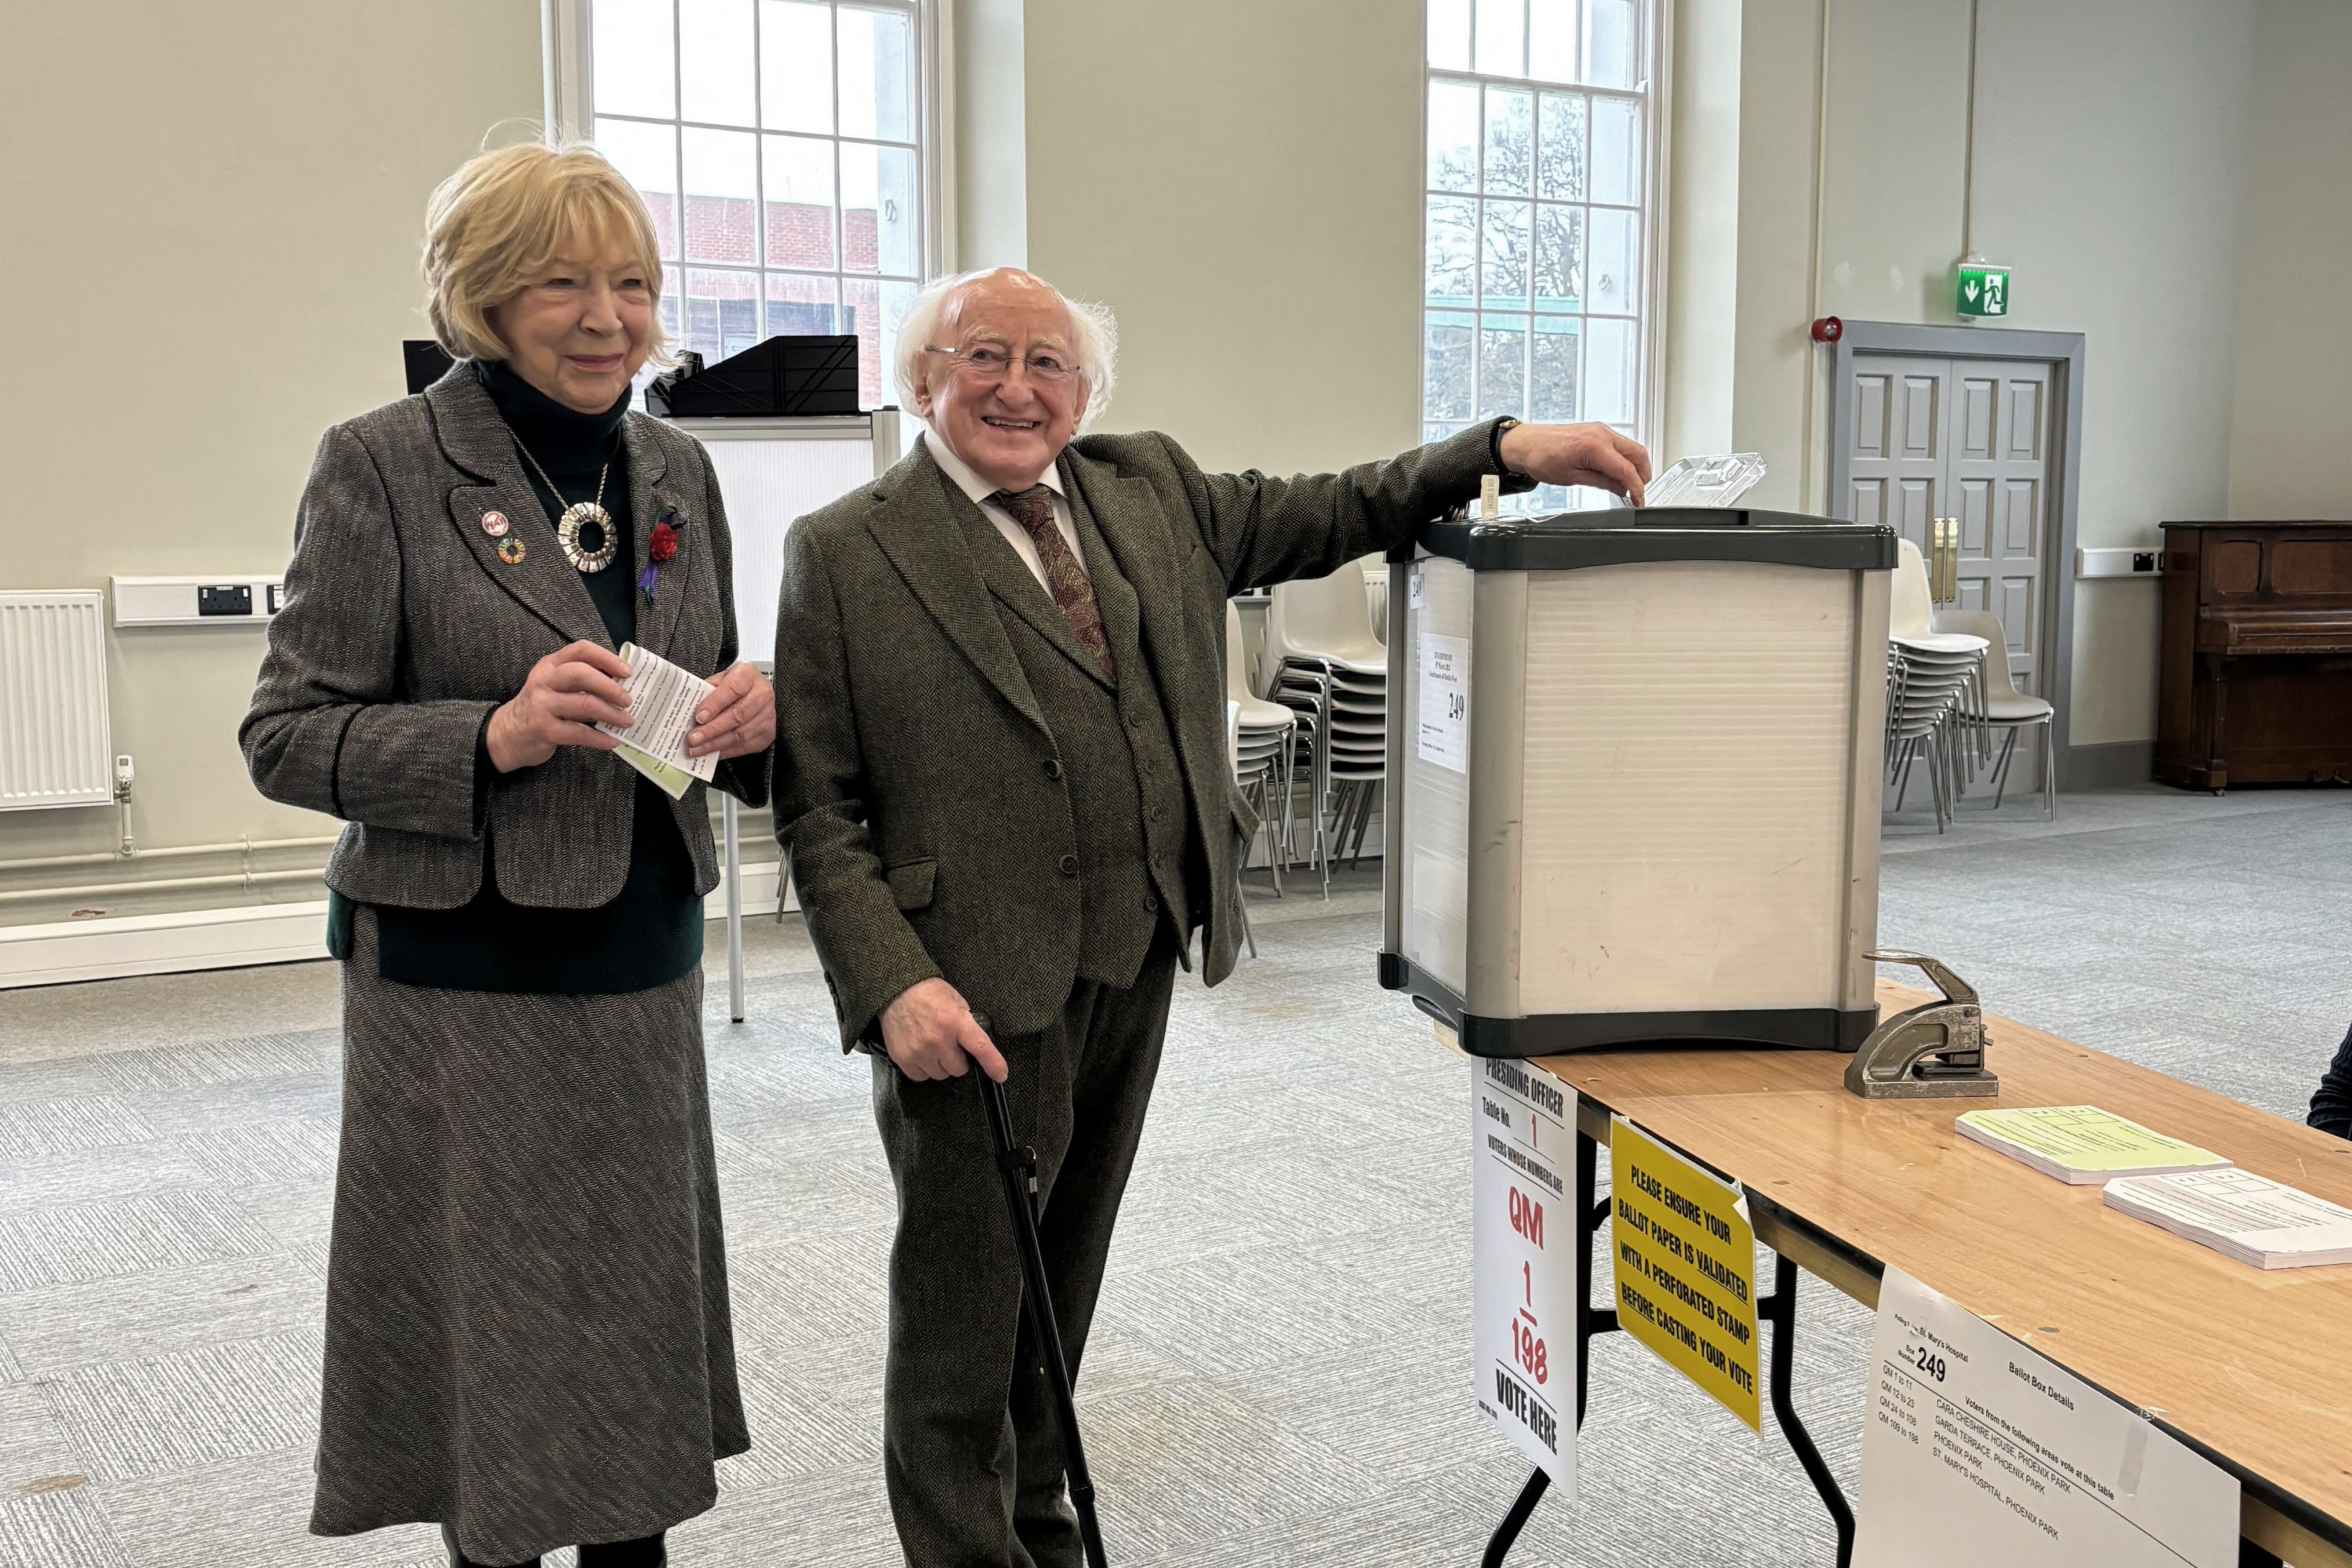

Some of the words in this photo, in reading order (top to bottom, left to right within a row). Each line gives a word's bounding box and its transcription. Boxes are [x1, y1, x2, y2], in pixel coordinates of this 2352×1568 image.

[1449, 692, 1464, 721] 249
[1486, 1058, 1529, 1097] PRESIDING
[1531, 1078, 1564, 1119] OFFICER
[1482, 1096, 1500, 1122] Table
[1501, 1107, 1511, 1129] No.
[1532, 1114, 1537, 1148] 1
[1488, 1133, 1507, 1158] VOTERS
[1507, 1145, 1526, 1170] WHOSE
[1527, 1158, 1553, 1188] NUMBERS
[1553, 1175, 1564, 1195] ARE
[1509, 1185, 1543, 1250] QM
[1631, 1164, 1663, 1203] PLEASE
[1664, 1186, 1702, 1227] ENSURE
[1703, 1209, 1732, 1246] YOUR
[1619, 1197, 1649, 1236] BALLOT
[1651, 1220, 1682, 1258] PAPER
[1684, 1240, 1694, 1265] IS
[1696, 1248, 1747, 1302] VALIDATED
[1524, 1260, 1531, 1308] 1
[1620, 1239, 1642, 1273] WITH
[1644, 1257, 1651, 1279] A
[1652, 1263, 1714, 1321] PERFORATED
[1717, 1305, 1750, 1346] STAMP
[1512, 1317, 1547, 1385] 198
[1621, 1280, 1655, 1322] BEFORE
[1656, 1307, 1697, 1352] CASTING
[1699, 1336, 1726, 1374] YOUR
[1728, 1358, 1753, 1396] VOTE
[1897, 1349, 1915, 1365] Number
[1917, 1347, 1946, 1383] 249
[1928, 1331, 1945, 1348] Mary's
[1946, 1343, 1968, 1362] Hospital
[1880, 1396, 1890, 1409] QM
[1891, 1403, 1897, 1414] 24
[1899, 1409, 1904, 1418] to
[1881, 1380, 1892, 1394] QM
[1893, 1388, 1900, 1399] 12
[1900, 1394, 1906, 1403] to
[1907, 1397, 1914, 1408] 23
[1883, 1365, 1893, 1378] QM
[1895, 1372, 1897, 1381] 1
[1899, 1376, 1904, 1385] to
[1906, 1380, 1912, 1390] 11
[2009, 1361, 2030, 1383] Ballot
[2031, 1376, 2046, 1394] Box
[2048, 1385, 2074, 1410] Details
[1496, 1367, 1527, 1425] VOTE
[1529, 1396, 1557, 1457] HERE
[1878, 1411, 1888, 1424] QM
[1891, 1419, 1900, 1432] 109
[1901, 1427, 1906, 1436] to
[1933, 1431, 1964, 1458] PHOENIX
[1964, 1450, 1983, 1471] PARK
[1935, 1415, 1958, 1437] GARDA
[1960, 1429, 1993, 1461] TERRACE,
[1994, 1453, 2025, 1482] PHOENIX
[2026, 1474, 2045, 1496] PARK
[1936, 1399, 1954, 1418] CARA
[1955, 1411, 1990, 1440] CHESHIRE
[1991, 1434, 2016, 1460] HOUSE,
[2018, 1451, 2049, 1480] PHOENIX
[2051, 1474, 2071, 1495] PARK
[1965, 1395, 1984, 1415] Voters
[1986, 1409, 2000, 1425] from
[2001, 1420, 2011, 1432] the
[2012, 1426, 2040, 1453] following
[2041, 1446, 2059, 1464] areas
[2060, 1459, 2074, 1474] vote
[2075, 1469, 2082, 1480] at
[2084, 1473, 2096, 1489] this
[2097, 1482, 2115, 1500] table
[1932, 1447, 1943, 1461] ST.
[1944, 1454, 1969, 1478] MARY'S
[1969, 1471, 2004, 1504] HOSPITAL,
[2005, 1496, 2037, 1526] PHOENIX
[2038, 1519, 2059, 1541] PARK
